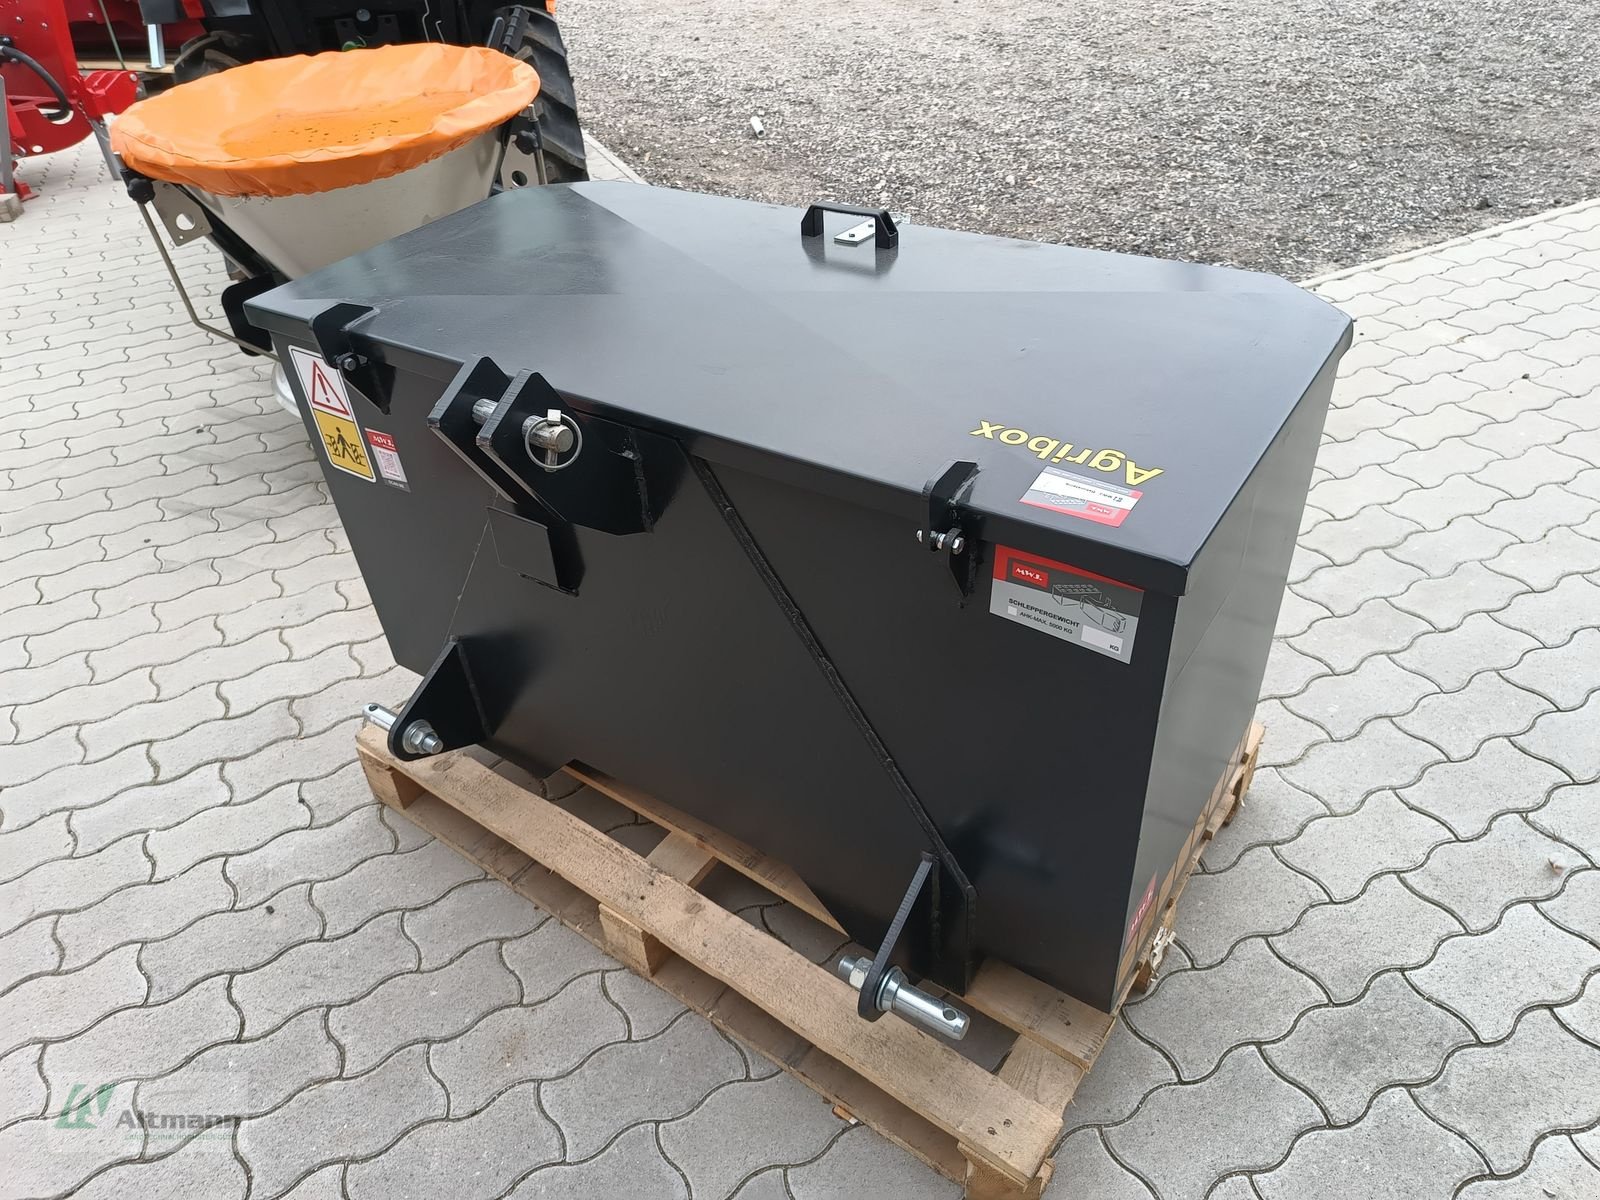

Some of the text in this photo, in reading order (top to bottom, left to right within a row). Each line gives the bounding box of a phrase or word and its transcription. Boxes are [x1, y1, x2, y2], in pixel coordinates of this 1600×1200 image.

[969, 419, 1164, 486] Agribox
[1008, 598, 1080, 628] SCHLEPPERGEWICHT
[1063, 626, 1073, 635] KG
[1109, 643, 1119, 652] KG
